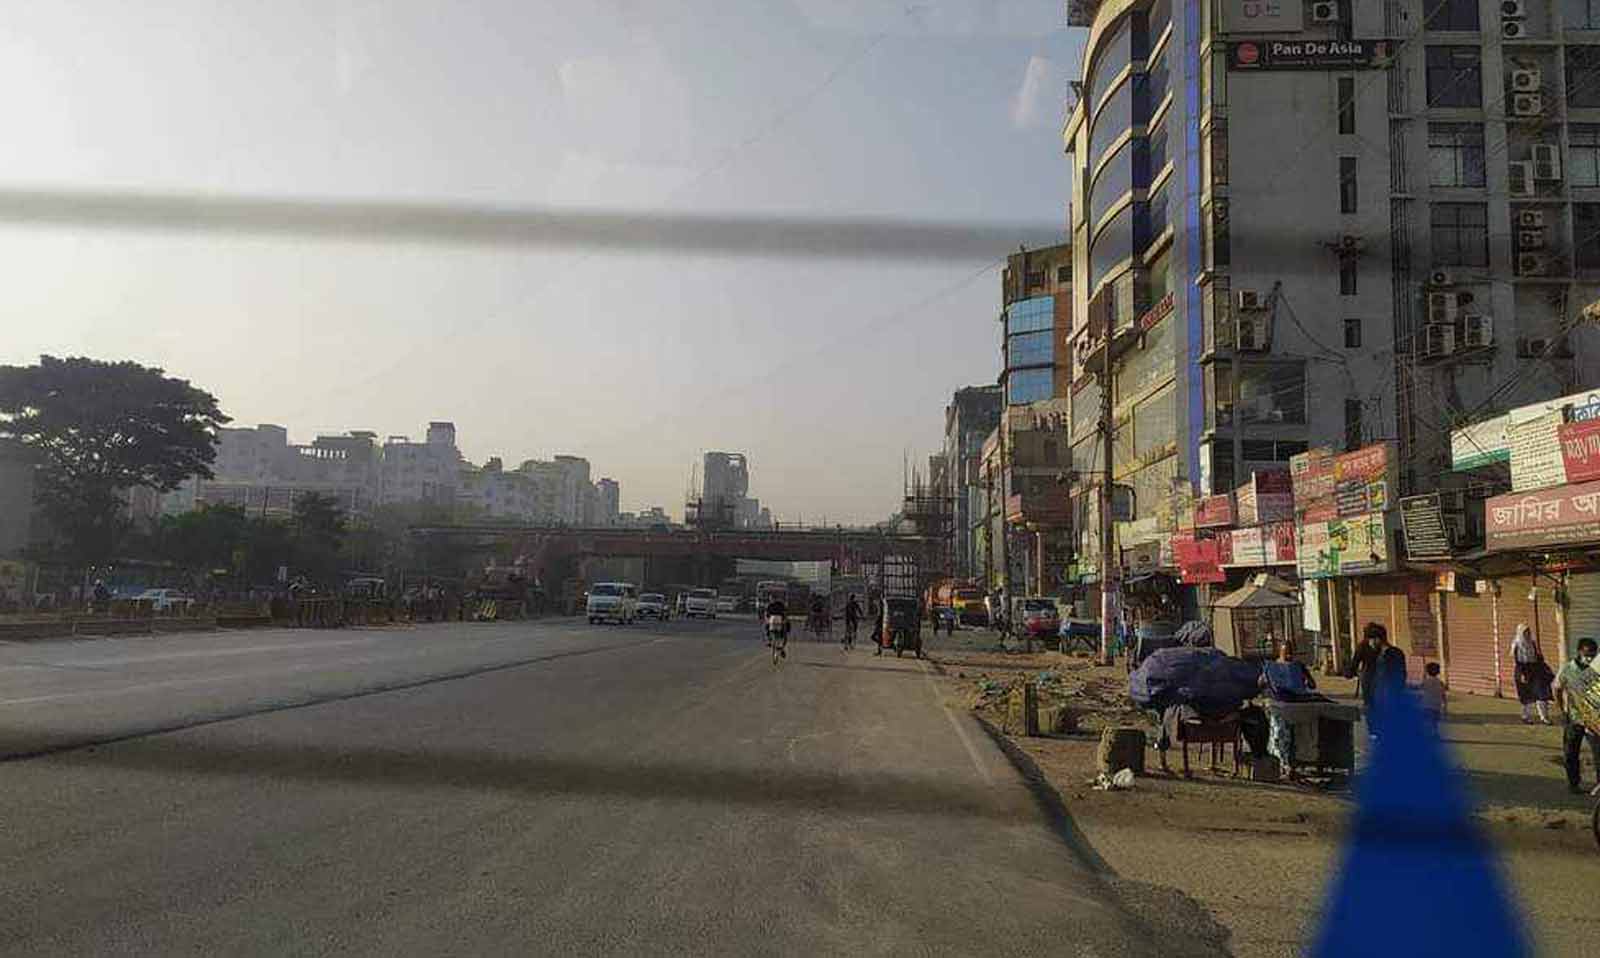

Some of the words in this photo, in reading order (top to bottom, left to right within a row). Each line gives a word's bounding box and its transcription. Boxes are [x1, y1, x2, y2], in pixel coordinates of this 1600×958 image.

[1272, 42, 1302, 55] Pan
[1305, 42, 1327, 54] De
[1329, 41, 1363, 54] Asia
